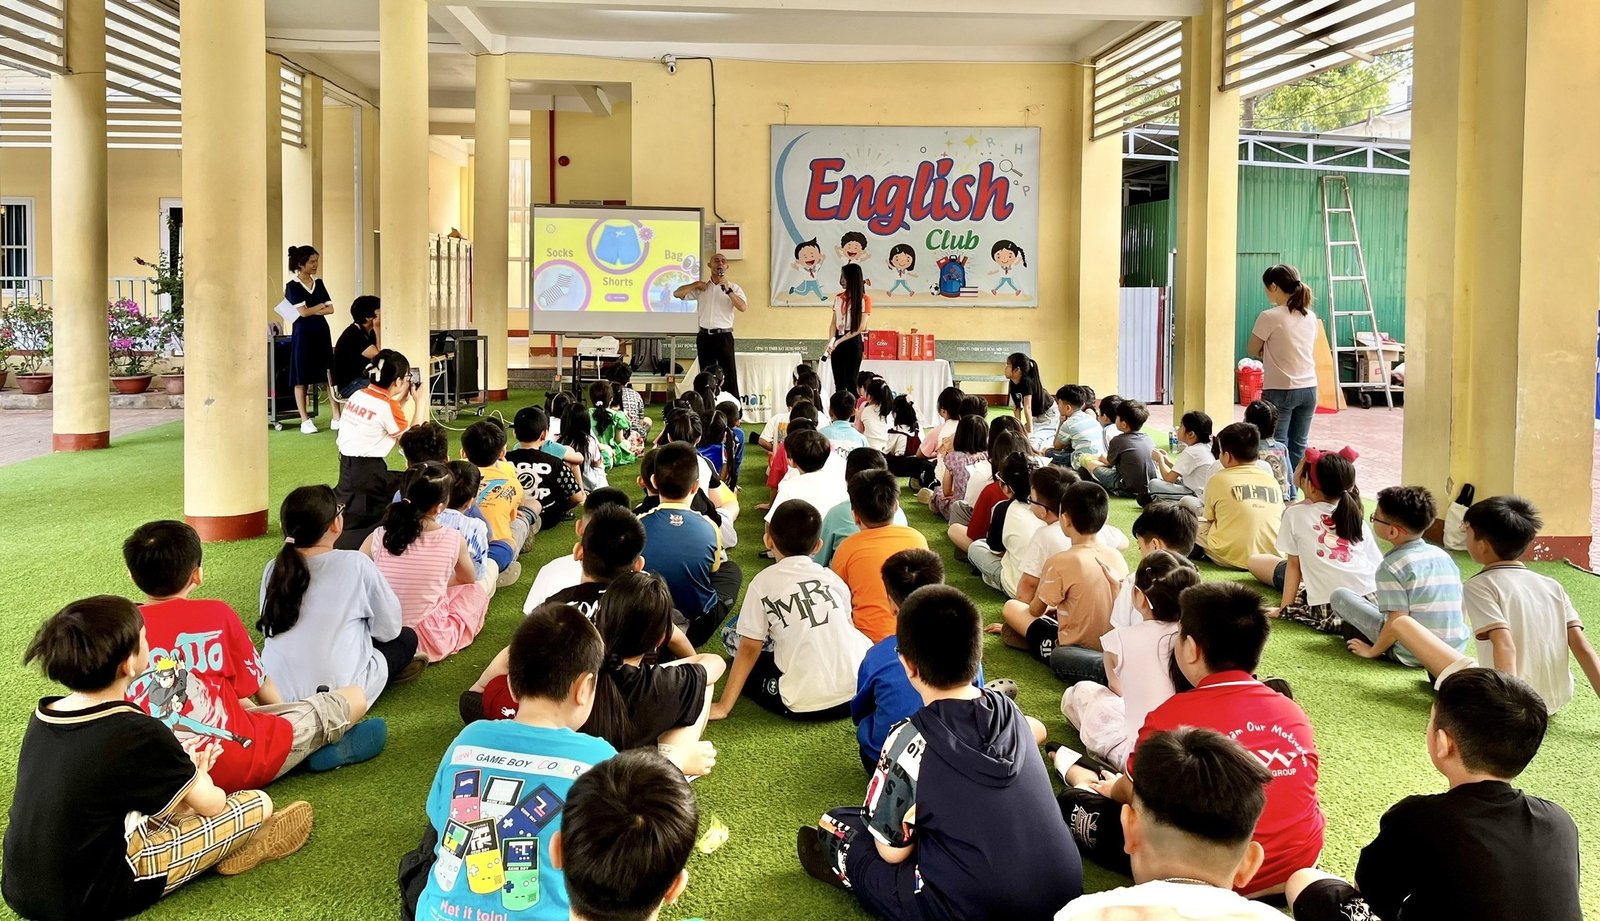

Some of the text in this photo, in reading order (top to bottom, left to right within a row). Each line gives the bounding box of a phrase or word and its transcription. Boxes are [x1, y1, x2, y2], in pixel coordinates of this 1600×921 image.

[1014, 143, 1023, 154] H
[804, 157, 1014, 236] English
[925, 228, 980, 251] Club
[546, 248, 574, 258] Socks
[664, 250, 683, 262] Bag
[602, 277, 633, 287] Shorts
[739, 388, 772, 406] mart
[1246, 721, 1267, 732] Our
[475, 753, 506, 764] GAME
[506, 758, 533, 768] BOY
[538, 759, 582, 776] COR
[1272, 767, 1297, 777] GROUP
